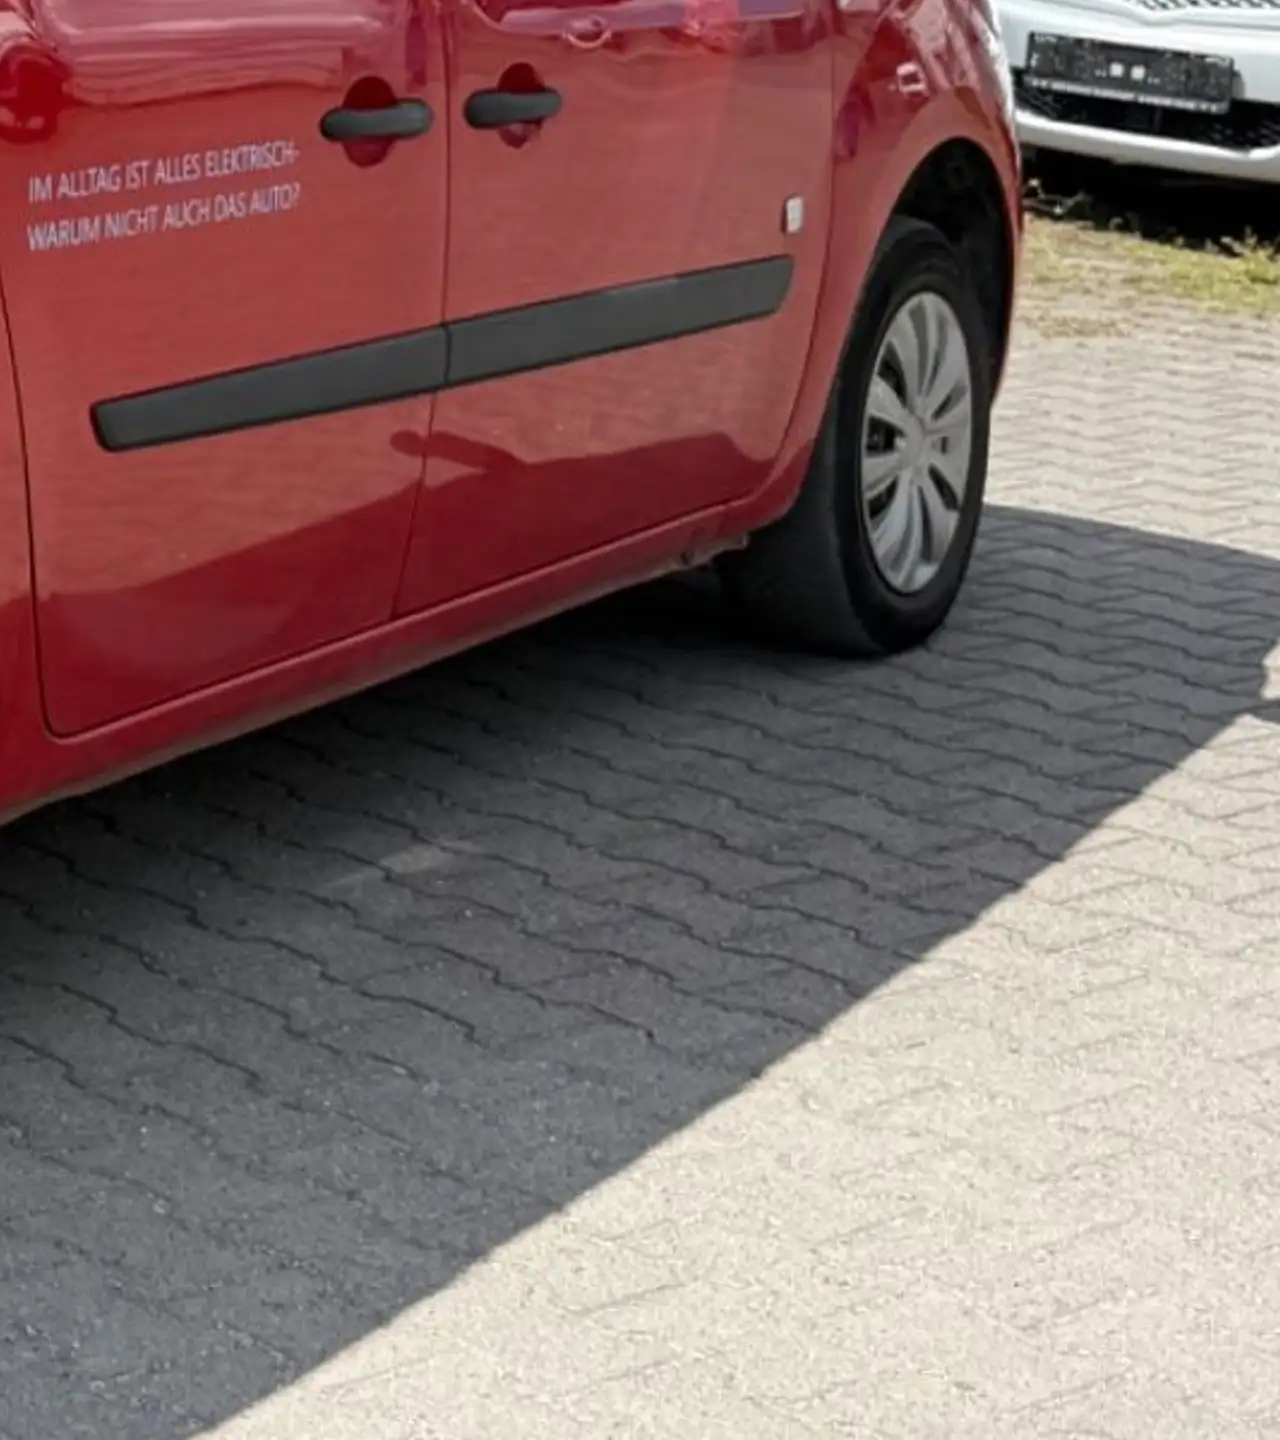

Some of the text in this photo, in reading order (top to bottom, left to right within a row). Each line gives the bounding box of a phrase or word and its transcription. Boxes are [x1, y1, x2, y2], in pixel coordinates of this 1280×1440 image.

[28, 173, 52, 203] IM
[57, 163, 121, 197] ALLTAG
[125, 160, 150, 190] IST
[154, 153, 201, 185] ALLES
[27, 181, 300, 251] WARUM NICHT AUCH DAS AUTO?
